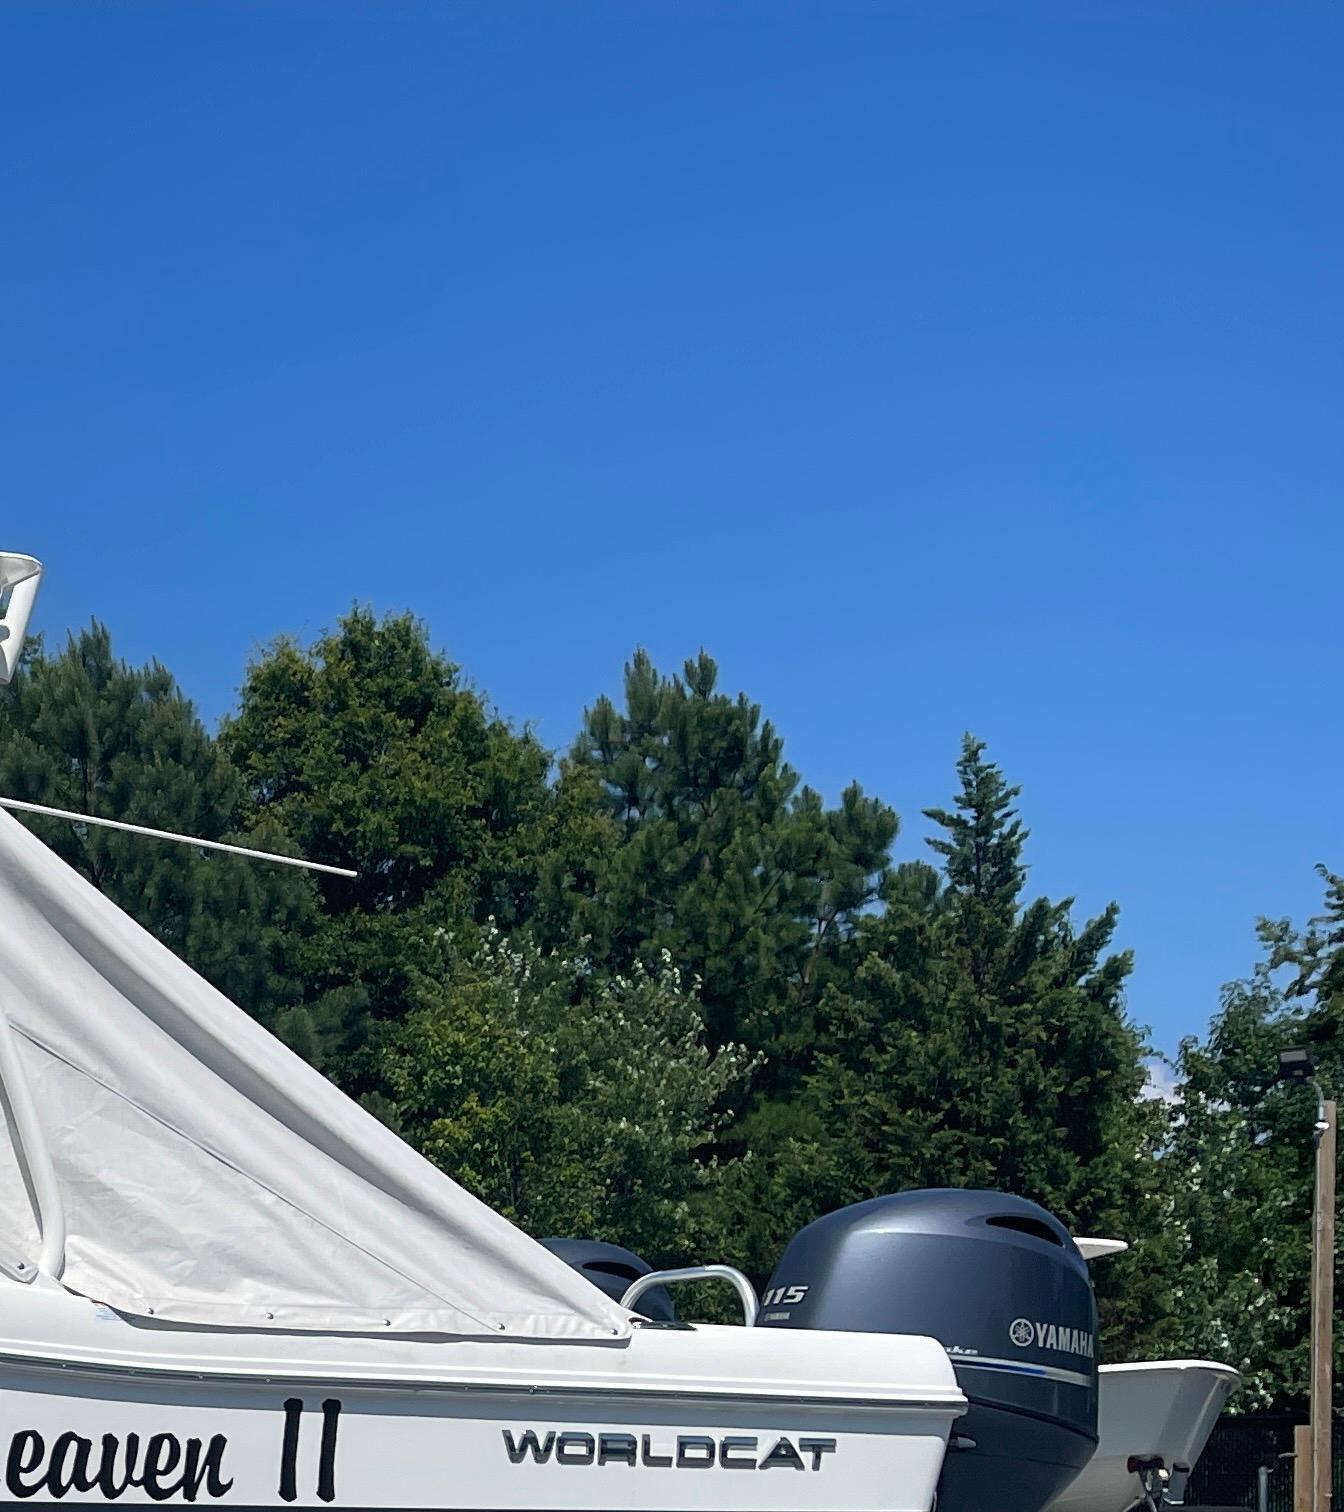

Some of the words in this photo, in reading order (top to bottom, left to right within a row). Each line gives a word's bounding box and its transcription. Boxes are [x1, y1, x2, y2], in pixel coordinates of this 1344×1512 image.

[764, 1286, 809, 1306] 115
[1035, 1322, 1095, 1359] YAMAHA
[278, 1397, 342, 1502] II
[502, 1429, 837, 1471] WORLDCAT
